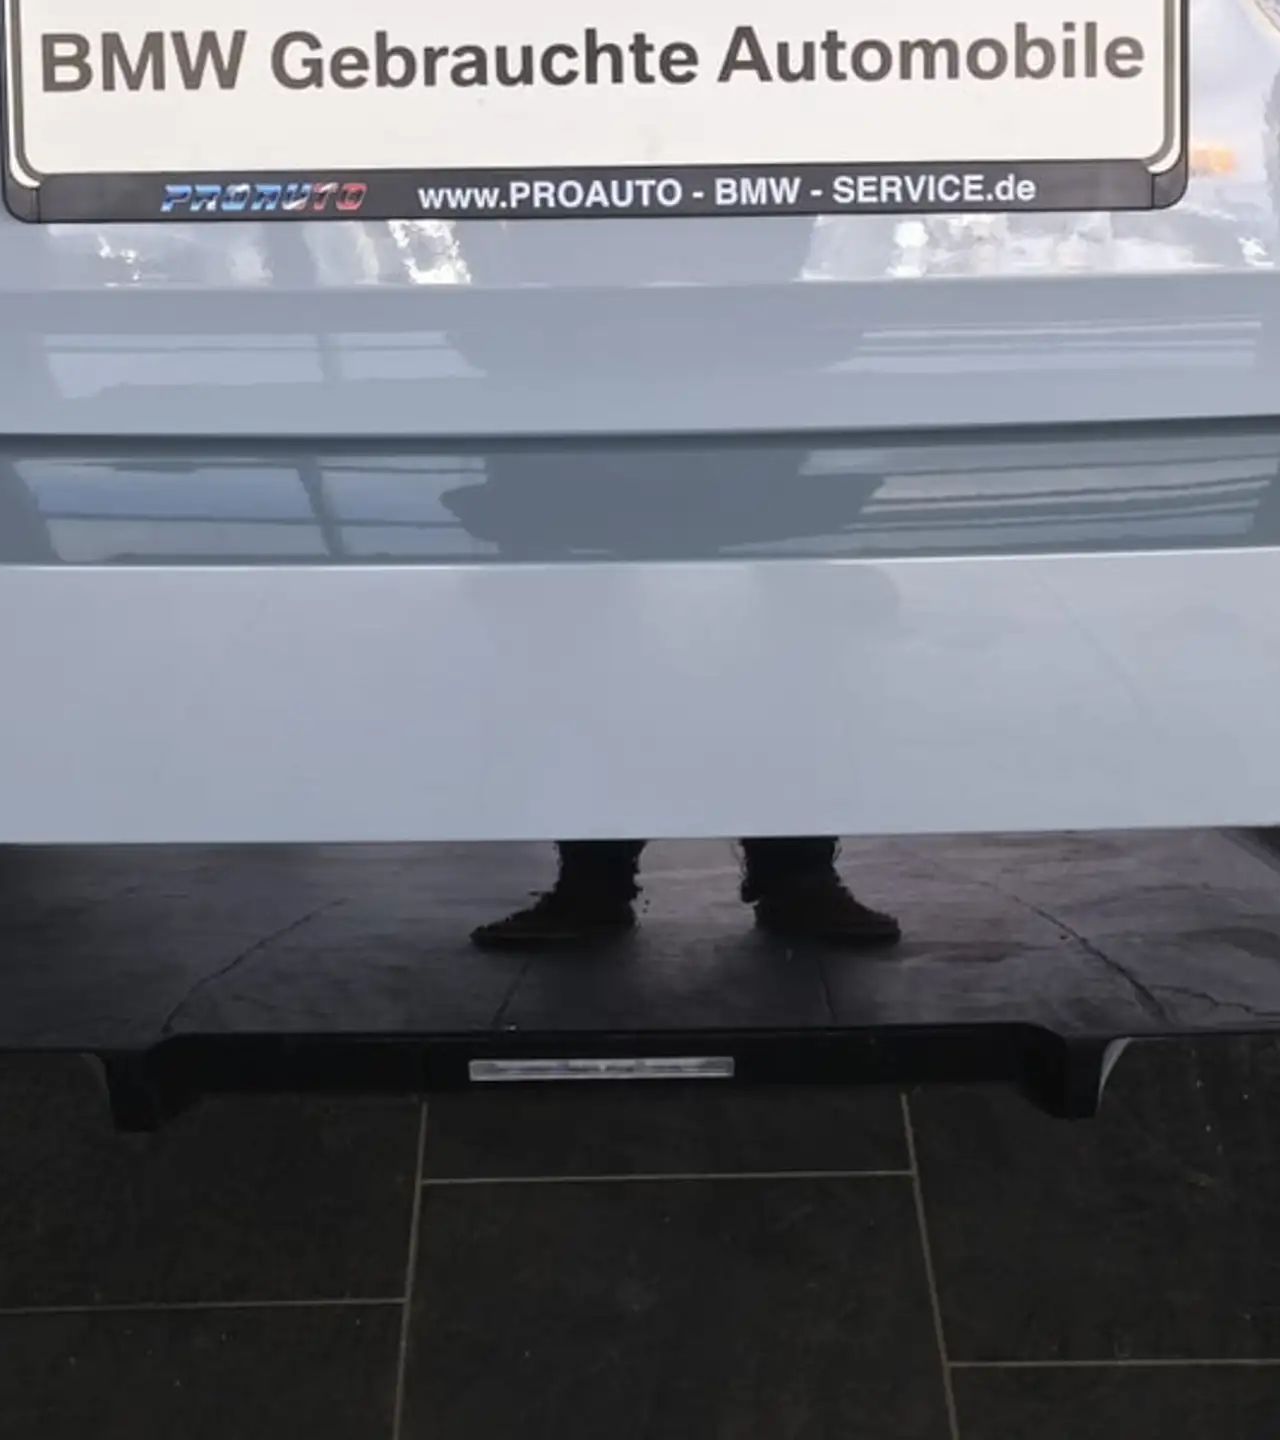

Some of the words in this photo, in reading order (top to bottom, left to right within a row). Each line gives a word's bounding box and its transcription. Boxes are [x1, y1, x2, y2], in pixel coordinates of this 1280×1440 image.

[39, 29, 246, 93] BMW
[270, 25, 699, 90] Gebrauchte
[716, 19, 1146, 84] Automobile
[160, 183, 368, 213] PROAUTO
[417, 177, 682, 210] www.PROAUTO
[714, 177, 801, 206] BMW
[832, 173, 1036, 203] SERVICE.de
